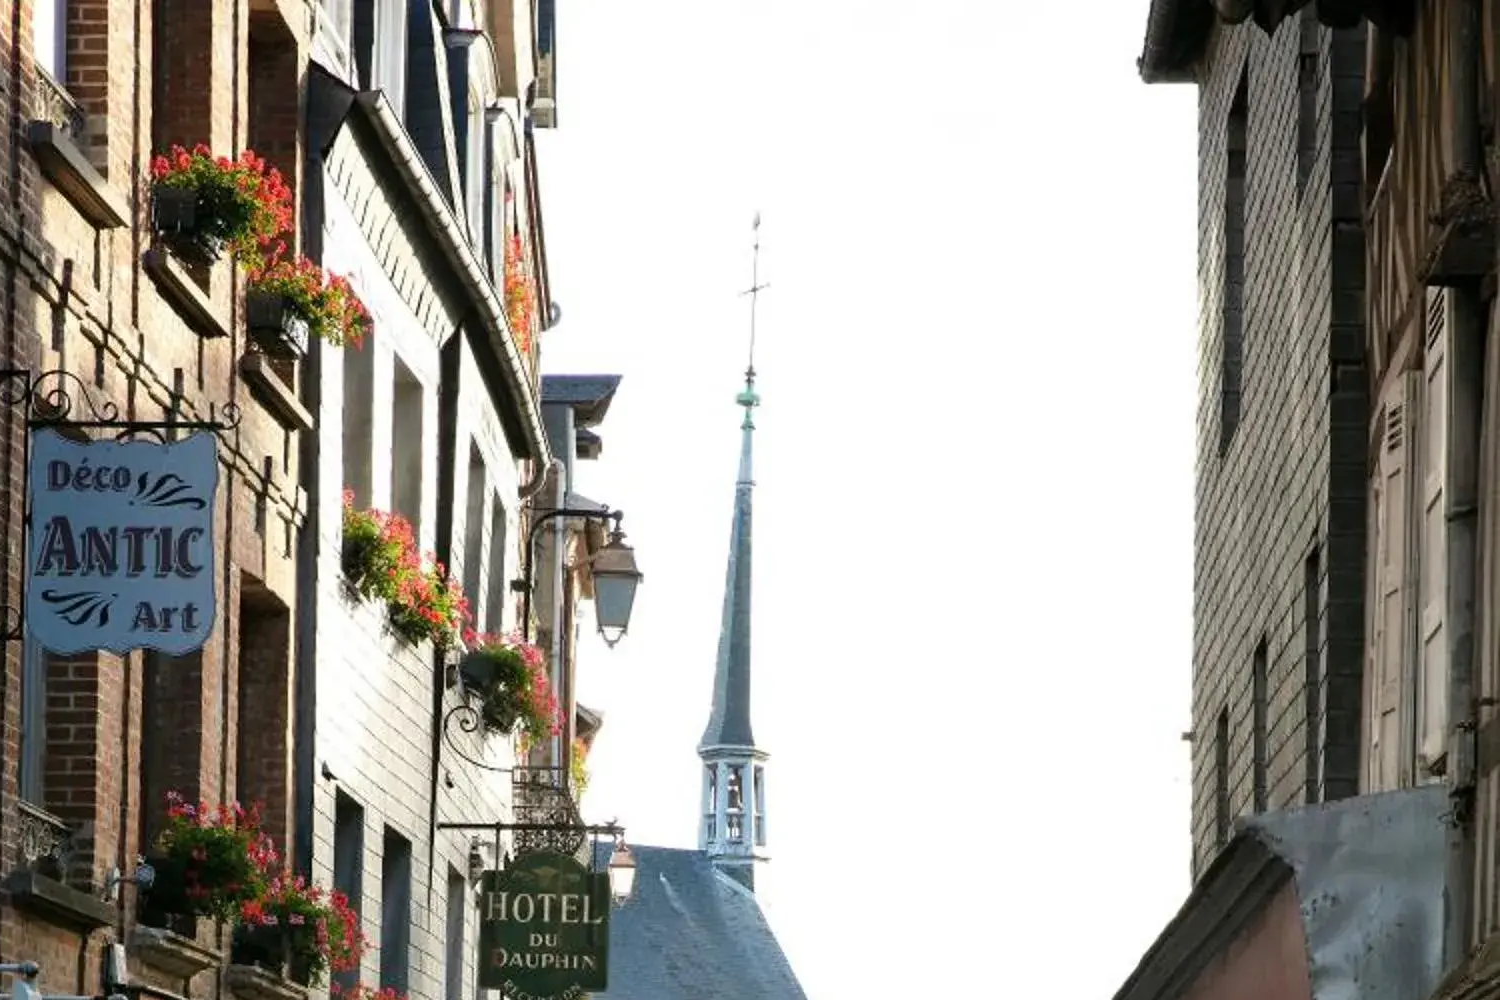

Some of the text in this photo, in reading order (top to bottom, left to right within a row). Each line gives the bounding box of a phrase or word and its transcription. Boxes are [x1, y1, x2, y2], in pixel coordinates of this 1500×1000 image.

[47, 457, 132, 493] Déco
[34, 515, 205, 579] ANTIC
[130, 601, 200, 633] Art
[485, 891, 604, 924] HOTEL
[529, 932, 557, 947] DU
[491, 946, 597, 970] DAUPHIN
